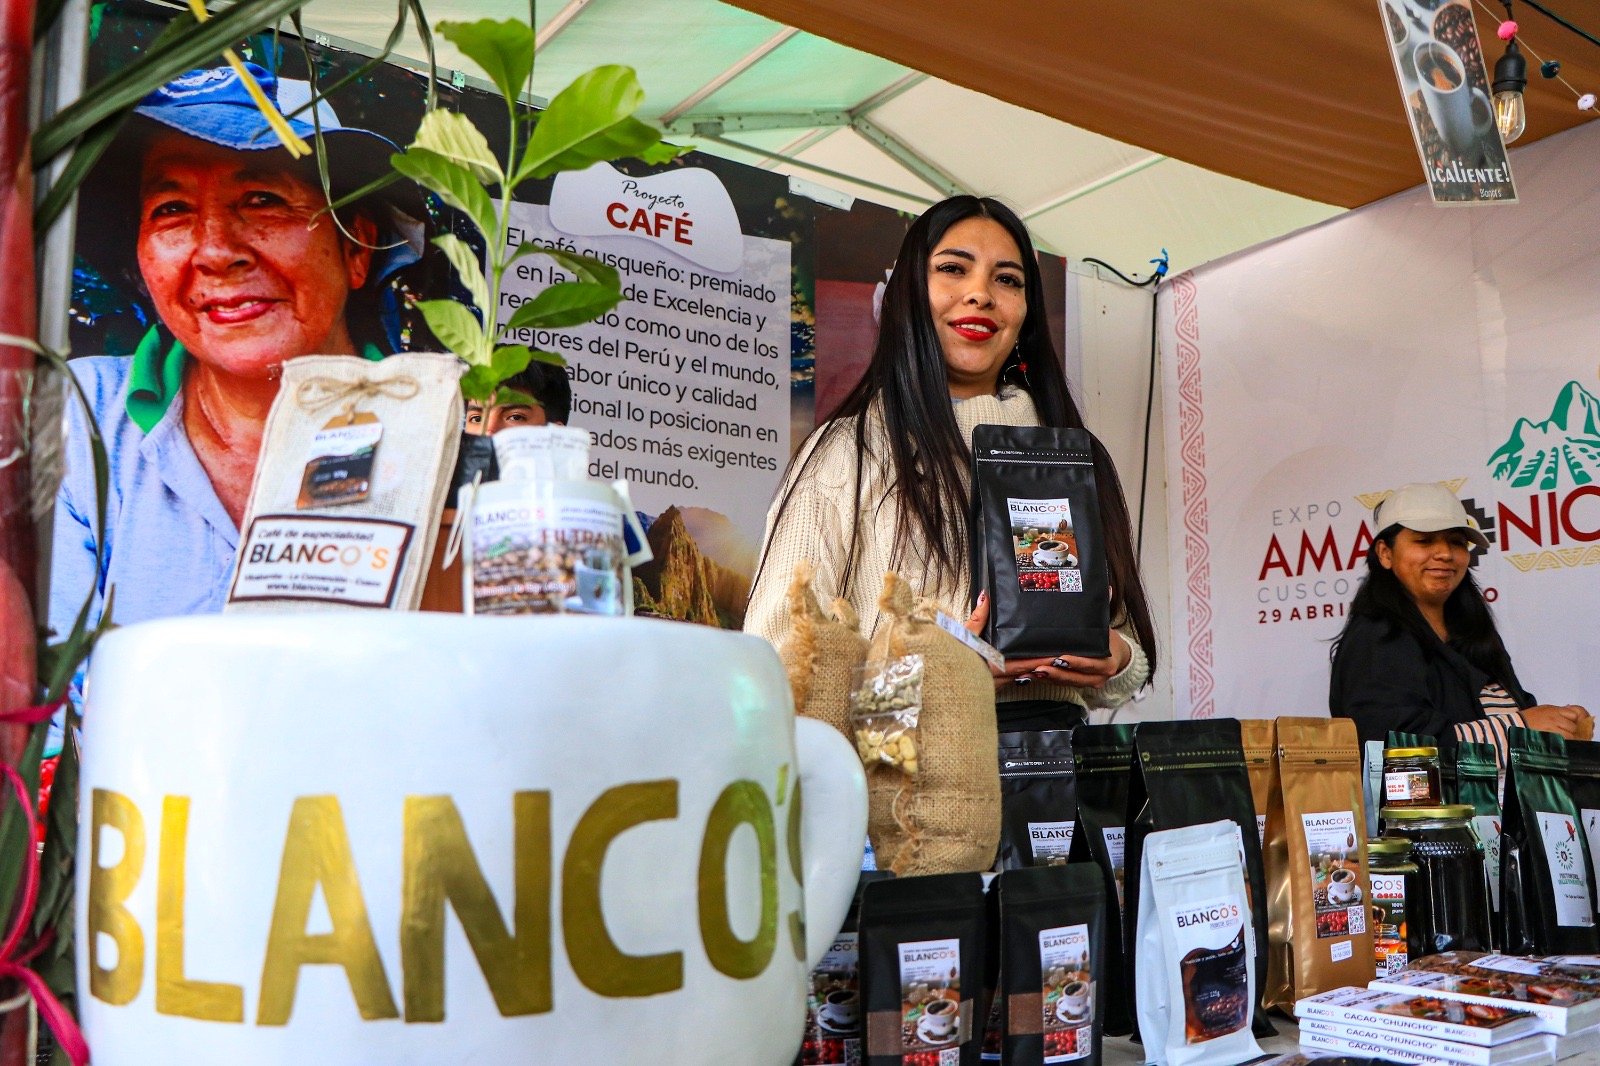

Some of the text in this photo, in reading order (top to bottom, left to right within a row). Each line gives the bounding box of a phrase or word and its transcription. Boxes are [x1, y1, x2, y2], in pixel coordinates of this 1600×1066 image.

[622, 180, 685, 210] Proyecto
[606, 202, 693, 245] CAFÉ
[506, 227, 525, 247] El
[690, 271, 776, 303] premiado
[517, 264, 543, 283] en
[550, 266, 566, 284] la
[623, 284, 648, 304] de
[654, 288, 751, 326] Excelencia
[756, 313, 767, 333] y
[625, 316, 681, 339] como
[686, 327, 721, 348] uno
[726, 333, 749, 353] de
[754, 337, 779, 359] los
[497, 322, 780, 391] mejores del Perú y el mundo,
[566, 363, 758, 412] abor único y calidad
[574, 393, 779, 443] ional lo posicionan en
[589, 429, 637, 452] ados
[643, 432, 684, 458] más
[688, 443, 778, 471] exigentes
[588, 458, 700, 490] del mundo.
[1010, 504, 1067, 513] BLANCO'S
[1272, 500, 1342, 527] EXPO
[248, 542, 390, 571] BLANCO'S
[1257, 578, 1349, 604] CUSCO
[1258, 602, 1344, 624] 29 ABRI
[1032, 830, 1073, 839] BLANC
[1305, 817, 1352, 827] BLANCO'S
[1107, 833, 1125, 841] BLA
[1371, 880, 1402, 890] CO'S
[1176, 904, 1238, 928] BLANCO'S
[1043, 935, 1086, 948] BLANCO'S
[904, 950, 957, 963] BLANCO'S
[1306, 1007, 1335, 1017] BLANCO'S
[1344, 1012, 1377, 1023] CACAO
[1379, 1017, 1438, 1032] "CHUNCHO"
[1310, 1022, 1337, 1032] BLANCO'S
[1346, 1028, 1378, 1039] CACAO
[1380, 1034, 1437, 1049] "CHUNCHO"
[1311, 1035, 1338, 1045] BLANCO'S
[1348, 1041, 1381, 1053] CACAO
[1383, 1047, 1441, 1064] "CHUNCHO"
